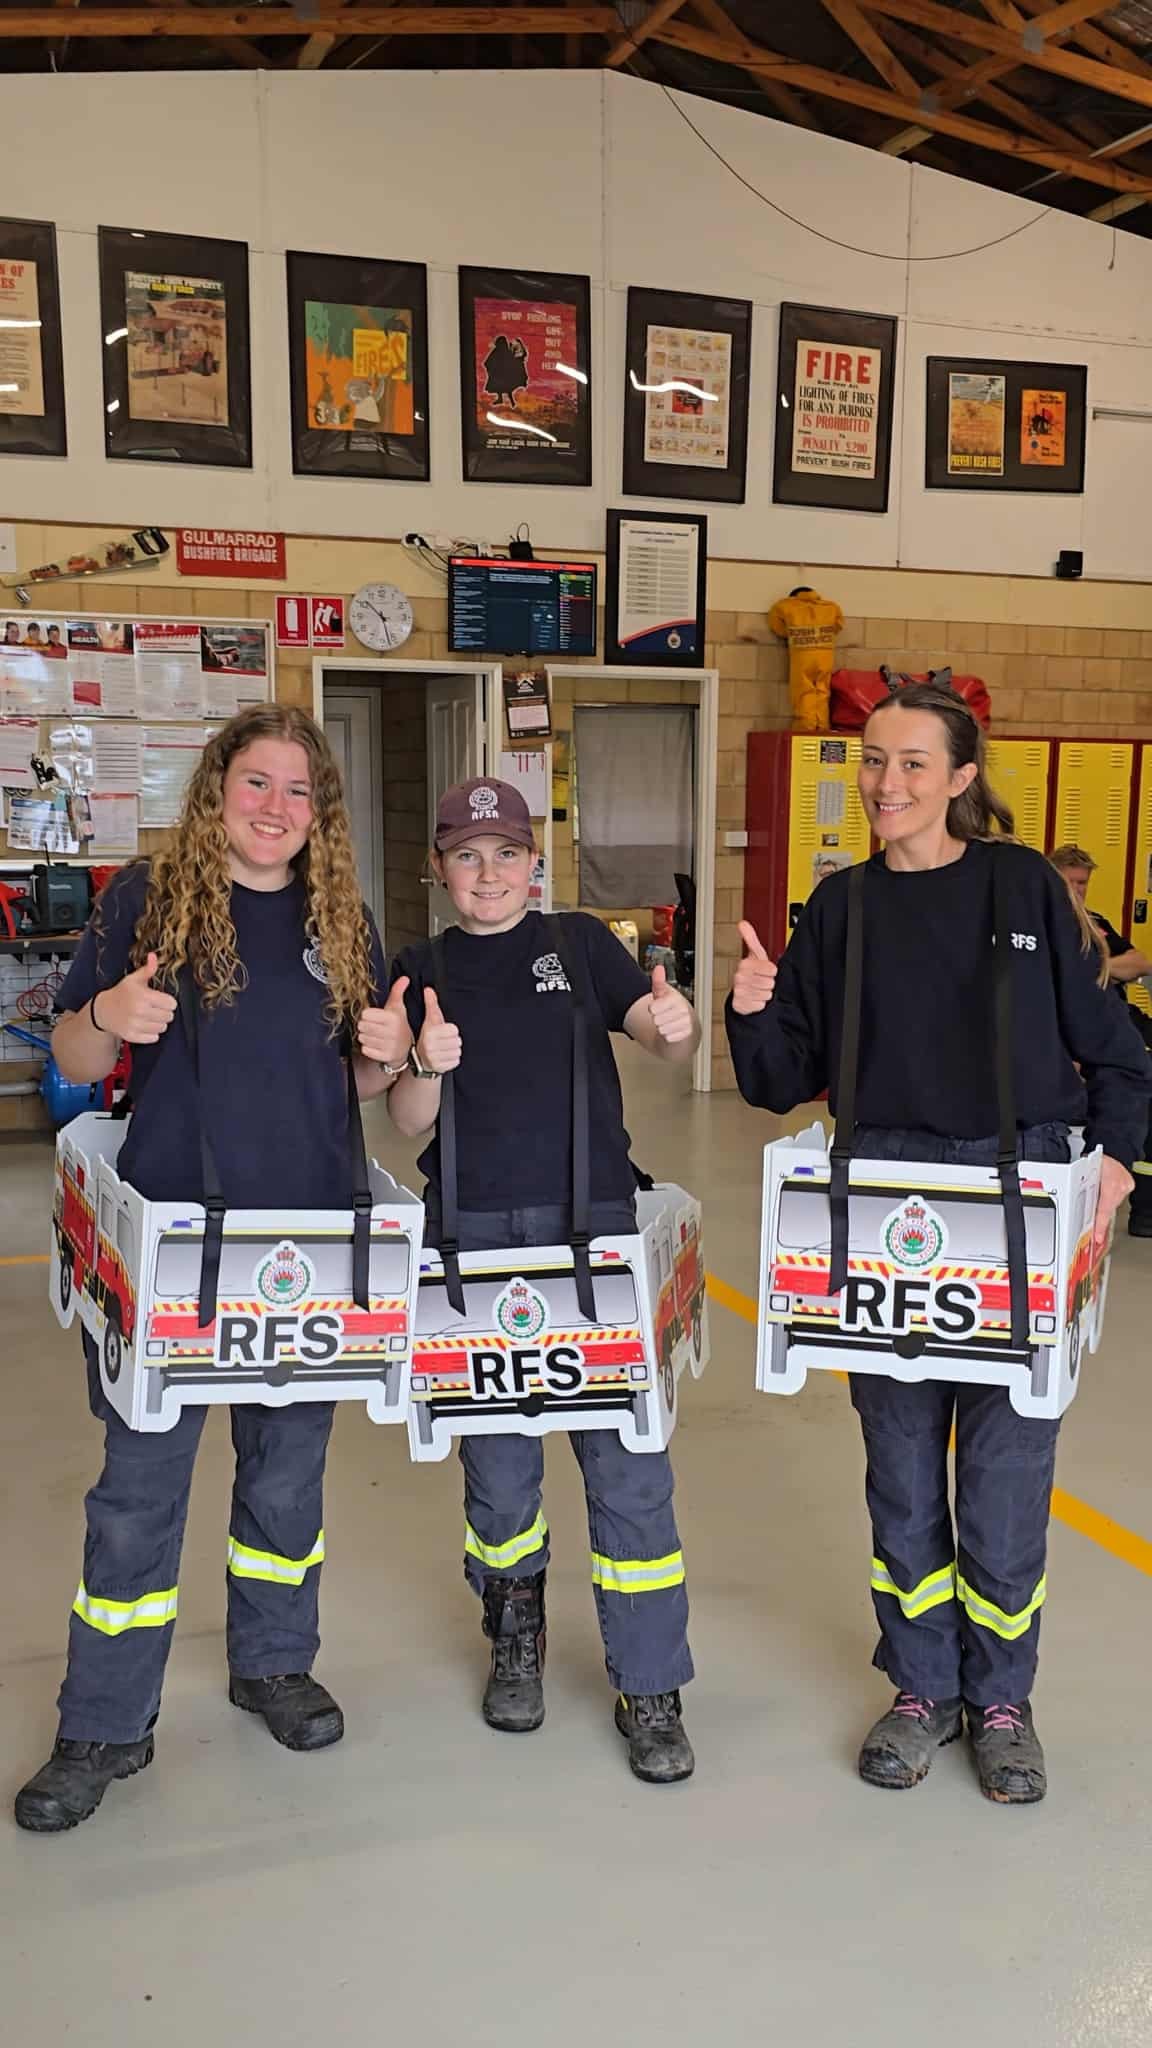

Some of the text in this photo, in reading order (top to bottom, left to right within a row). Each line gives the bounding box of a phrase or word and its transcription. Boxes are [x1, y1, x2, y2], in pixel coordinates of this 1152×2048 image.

[502, 312, 522, 320] STOP
[355, 335, 405, 374] FIRES
[806, 349, 872, 384] FIRE
[799, 386, 875, 405] LIGHTING OF FIRES
[799, 399, 873, 418] FOR ANY PURPOSE
[802, 413, 871, 433] IS PROHIBITED
[802, 436, 840, 452] PENALTY
[795, 455, 872, 471] PREVENT BUSH FIRES
[951, 455, 1001, 468] PREVENT BUSH FIRES
[182, 530, 277, 548] GULMARRAD
[183, 544, 278, 563] BUSHFIRE BRIGADE
[471, 809, 500, 821] AFSA
[845, 1276, 977, 1334] RFS
[218, 1315, 340, 1362] RFS
[471, 1347, 582, 1395] RFS
